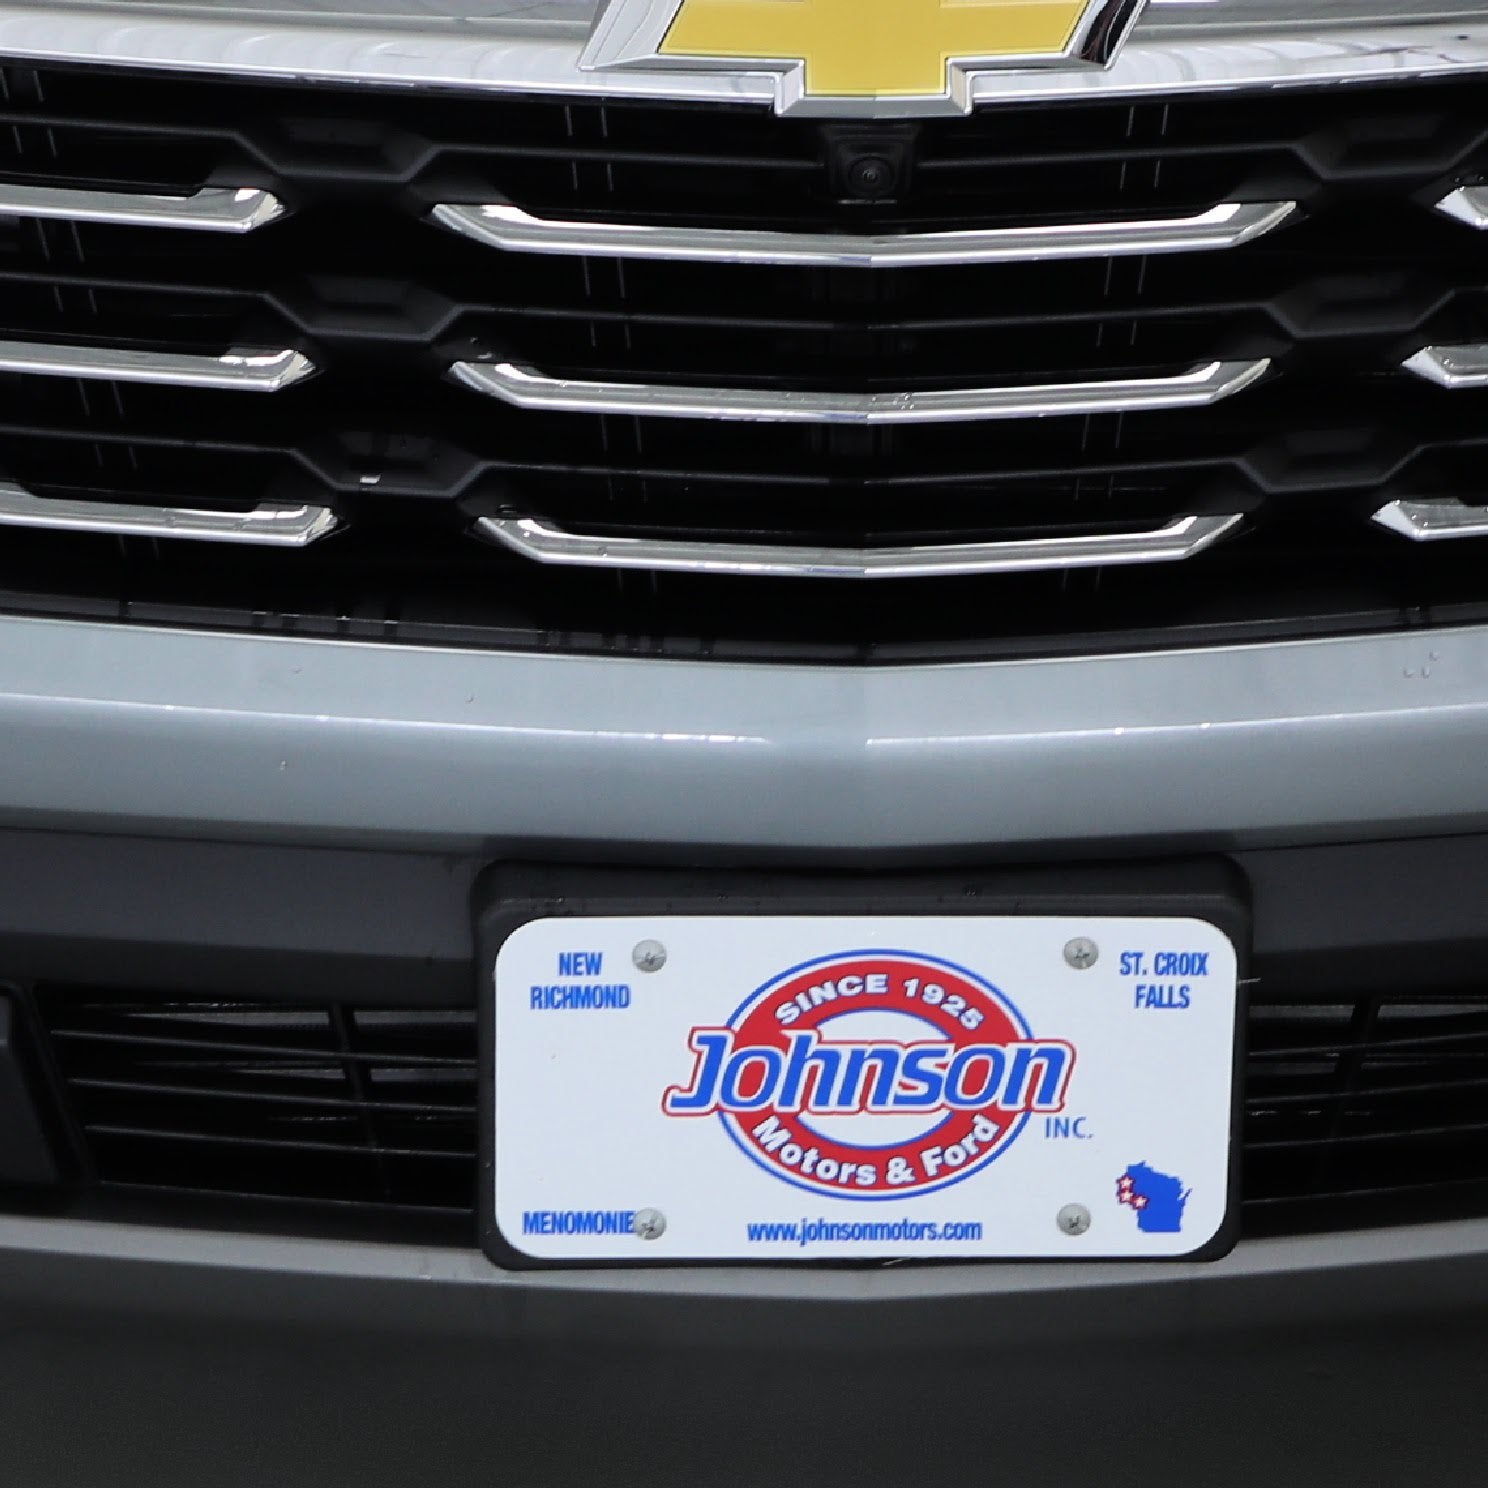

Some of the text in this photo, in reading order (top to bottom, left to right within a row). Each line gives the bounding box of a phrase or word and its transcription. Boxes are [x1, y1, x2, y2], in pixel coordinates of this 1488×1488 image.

[557, 950, 605, 978] NEW
[1119, 950, 1210, 978] ST. CROIX
[529, 983, 633, 1010] RICHMOND
[774, 973, 985, 1031] SINCE 1925
[1134, 982, 1193, 1010] FALLS
[668, 1030, 1070, 1112] Johnson
[1044, 1116, 1094, 1140] INC.
[752, 1113, 1001, 1188] Motors & Ford
[522, 1210, 636, 1236] MENOMONIE
[746, 1216, 984, 1244] www.johnsonmotors.com
